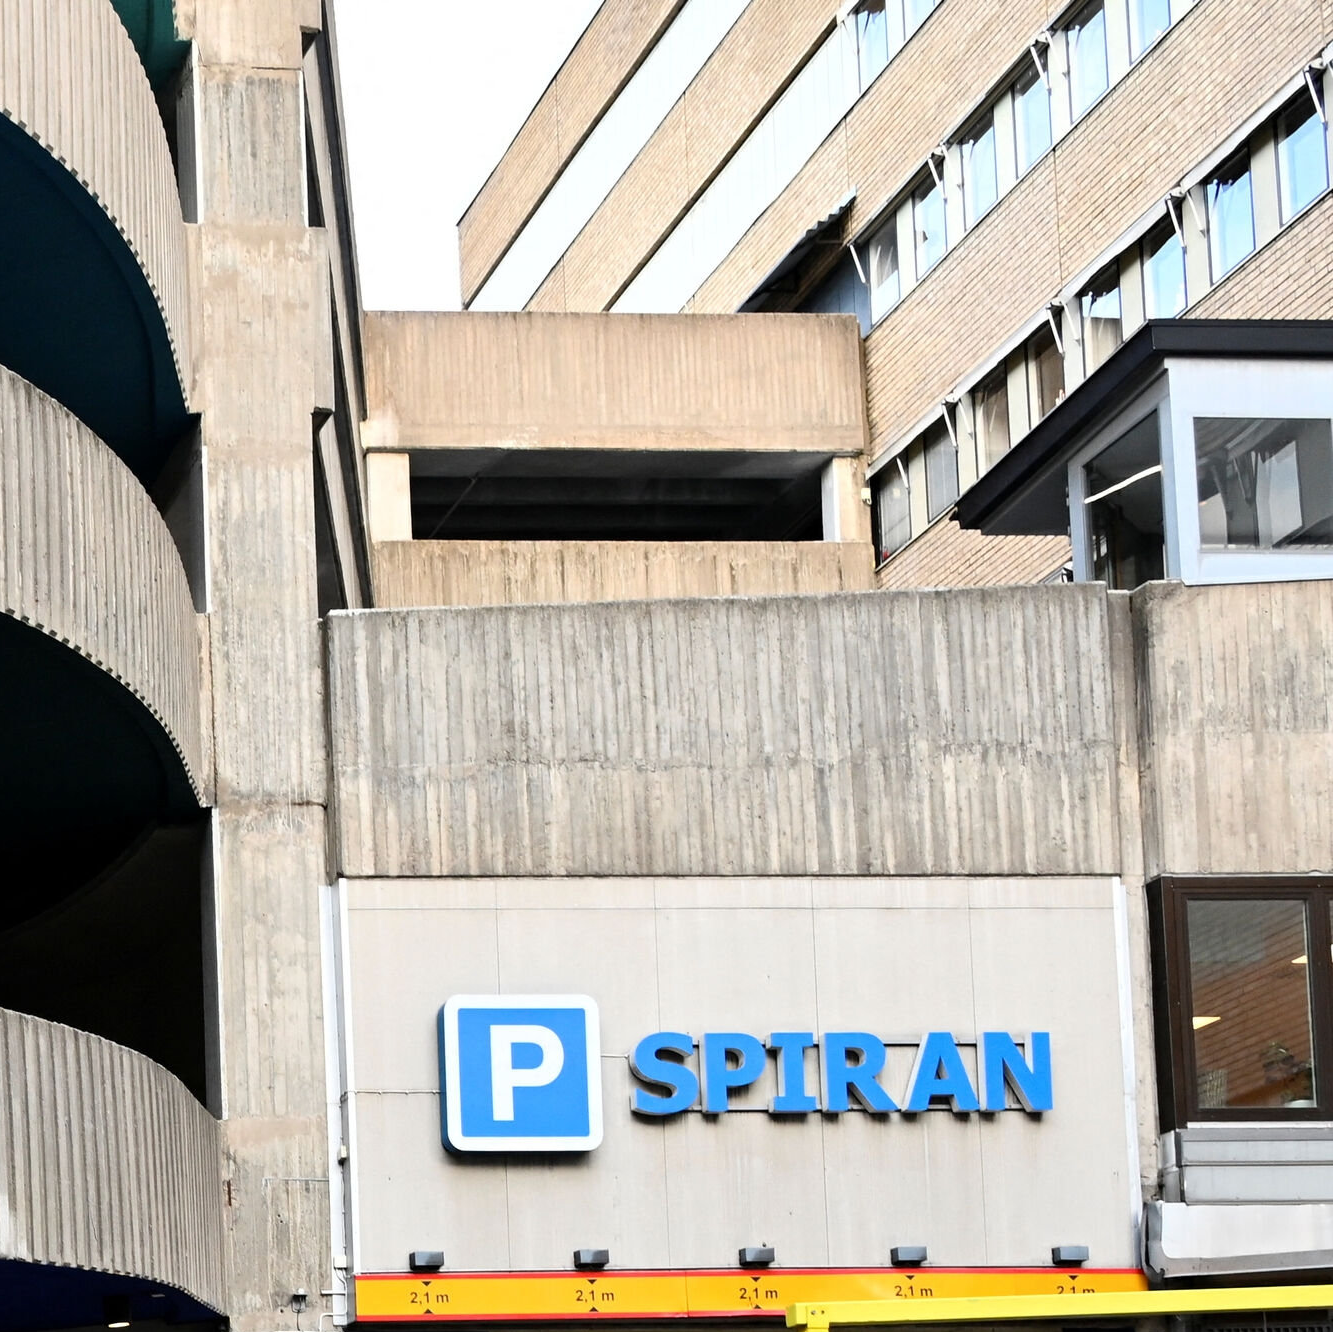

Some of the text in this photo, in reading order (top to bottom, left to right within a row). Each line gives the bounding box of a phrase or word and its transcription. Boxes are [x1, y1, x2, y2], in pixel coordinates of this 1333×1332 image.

[489, 1024, 1053, 1122] P SPIRAN
[410, 1291, 450, 1305] 2,1 m
[575, 1290, 615, 1304] 2,1 m
[739, 1288, 778, 1302] 2,1 m
[894, 1285, 933, 1299] 2,1 m
